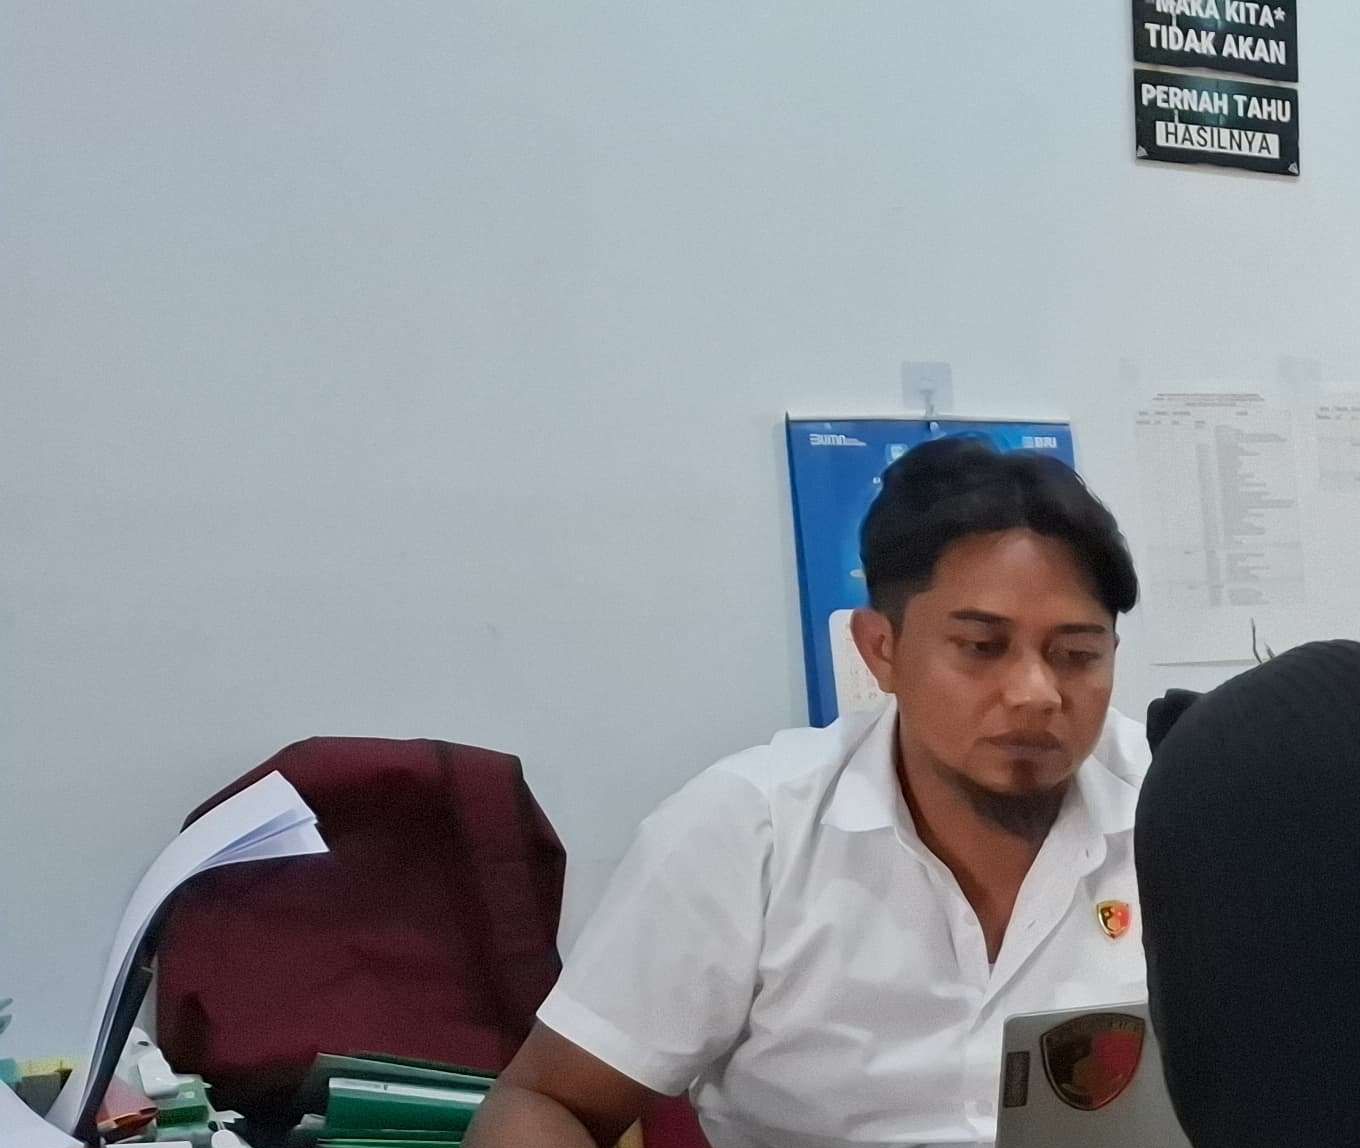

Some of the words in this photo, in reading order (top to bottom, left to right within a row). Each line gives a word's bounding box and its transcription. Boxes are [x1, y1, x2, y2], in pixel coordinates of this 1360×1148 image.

[1144, 22, 1217, 56] TIDAK
[1222, 33, 1286, 65] AKAN
[1140, 83, 1228, 116] PERNAH
[1233, 94, 1291, 122] TAHU
[1165, 122, 1271, 154] HASILNYA
